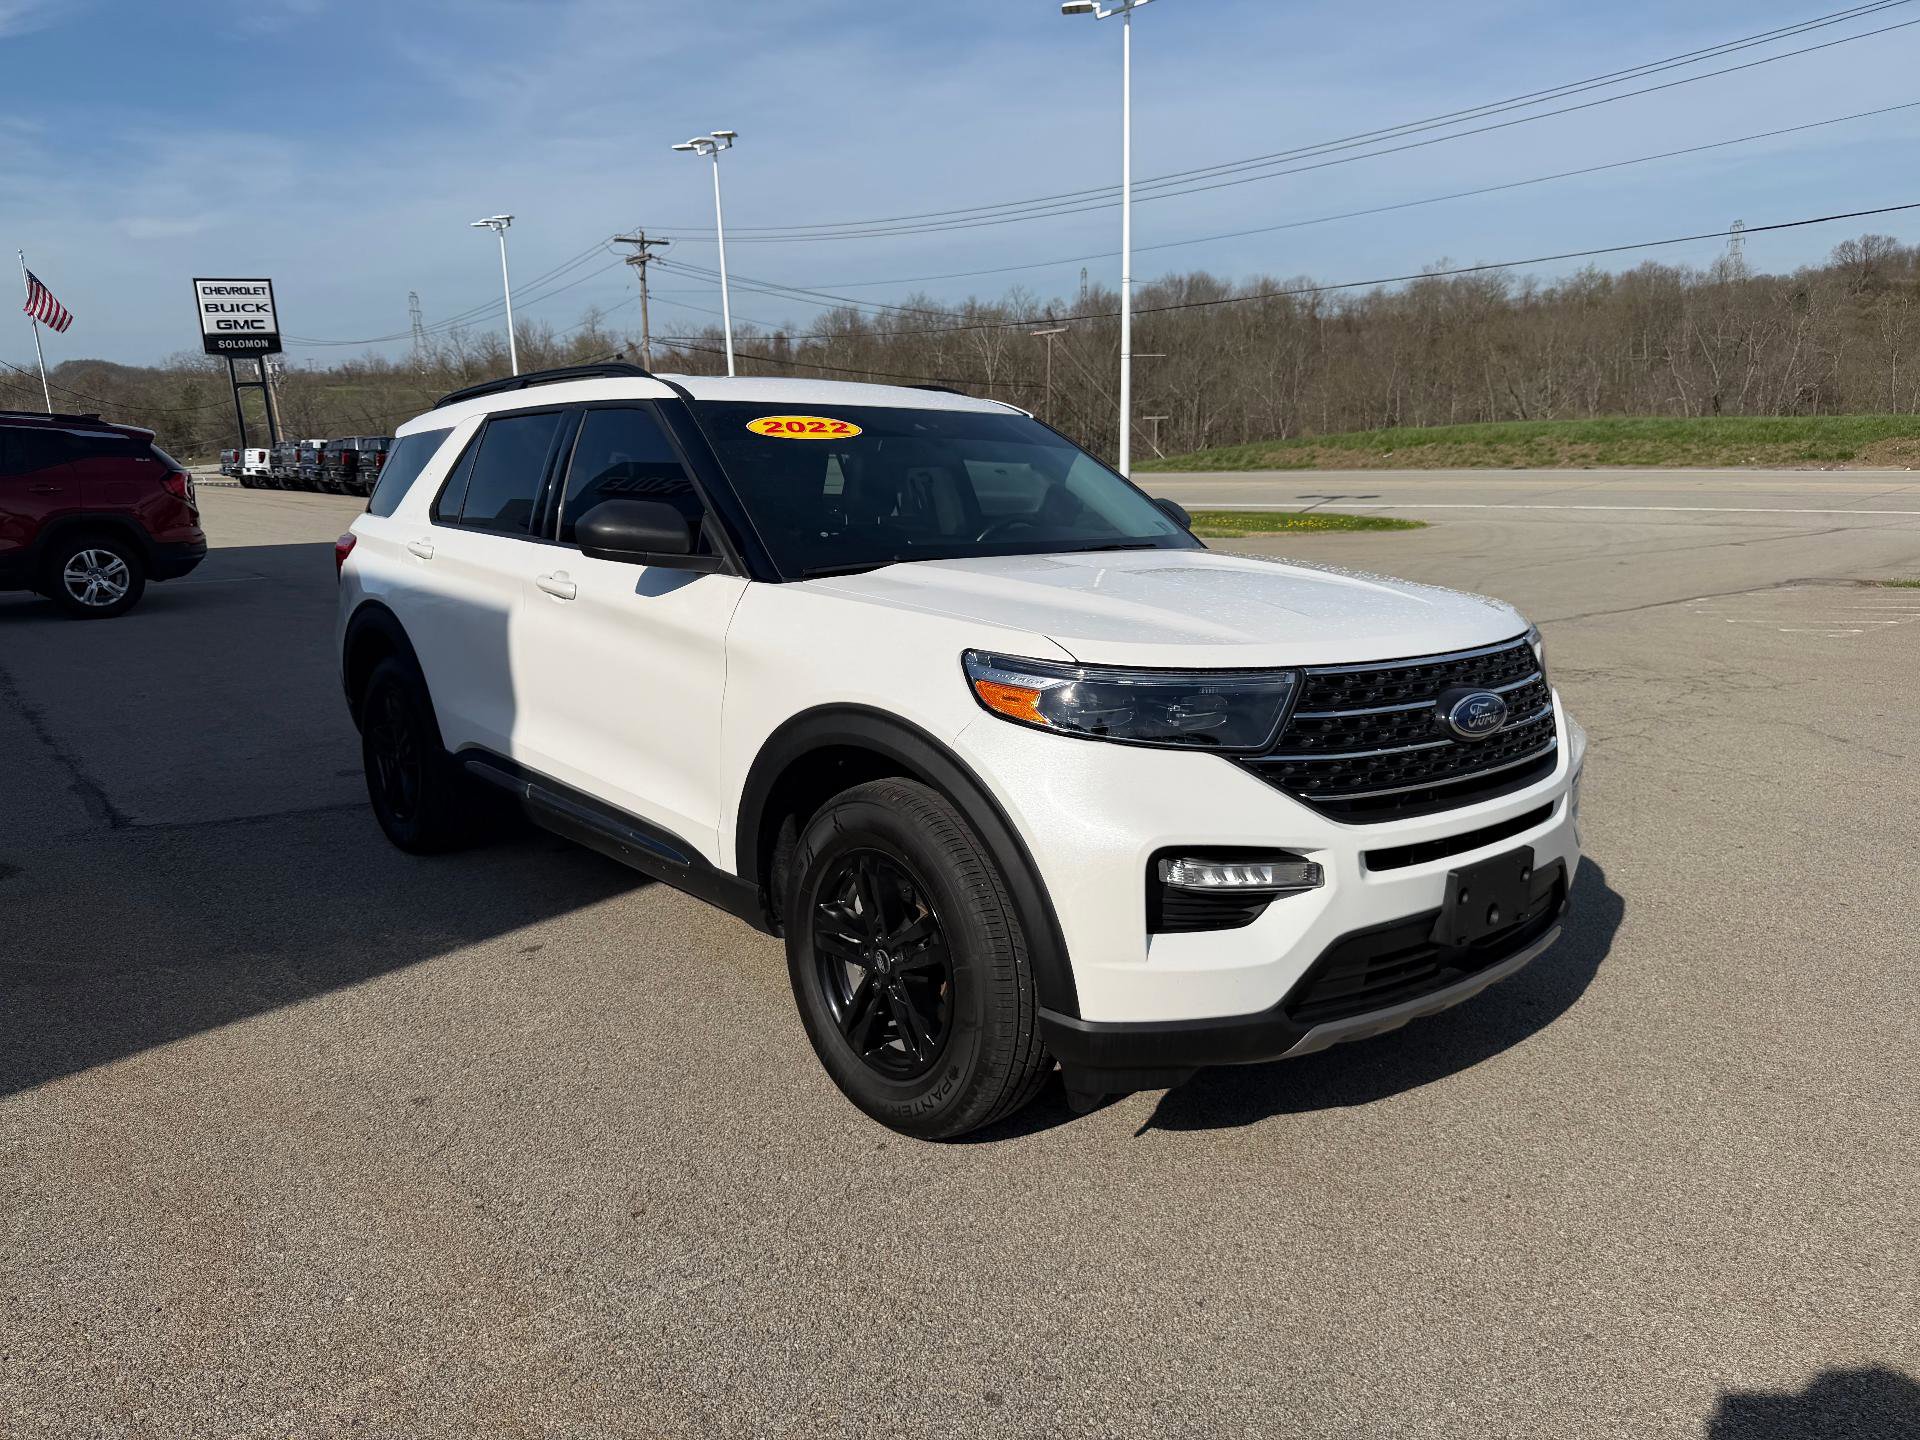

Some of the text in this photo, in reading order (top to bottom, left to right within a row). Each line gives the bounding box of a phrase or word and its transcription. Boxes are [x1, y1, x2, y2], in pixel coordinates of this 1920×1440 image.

[202, 286, 267, 296] CHEVROLET
[204, 303, 271, 313] BUICK
[216, 319, 267, 330] GMC
[218, 339, 269, 349] SOLOMON
[763, 421, 851, 434] 2022
[1467, 702, 1498, 728] Ford
